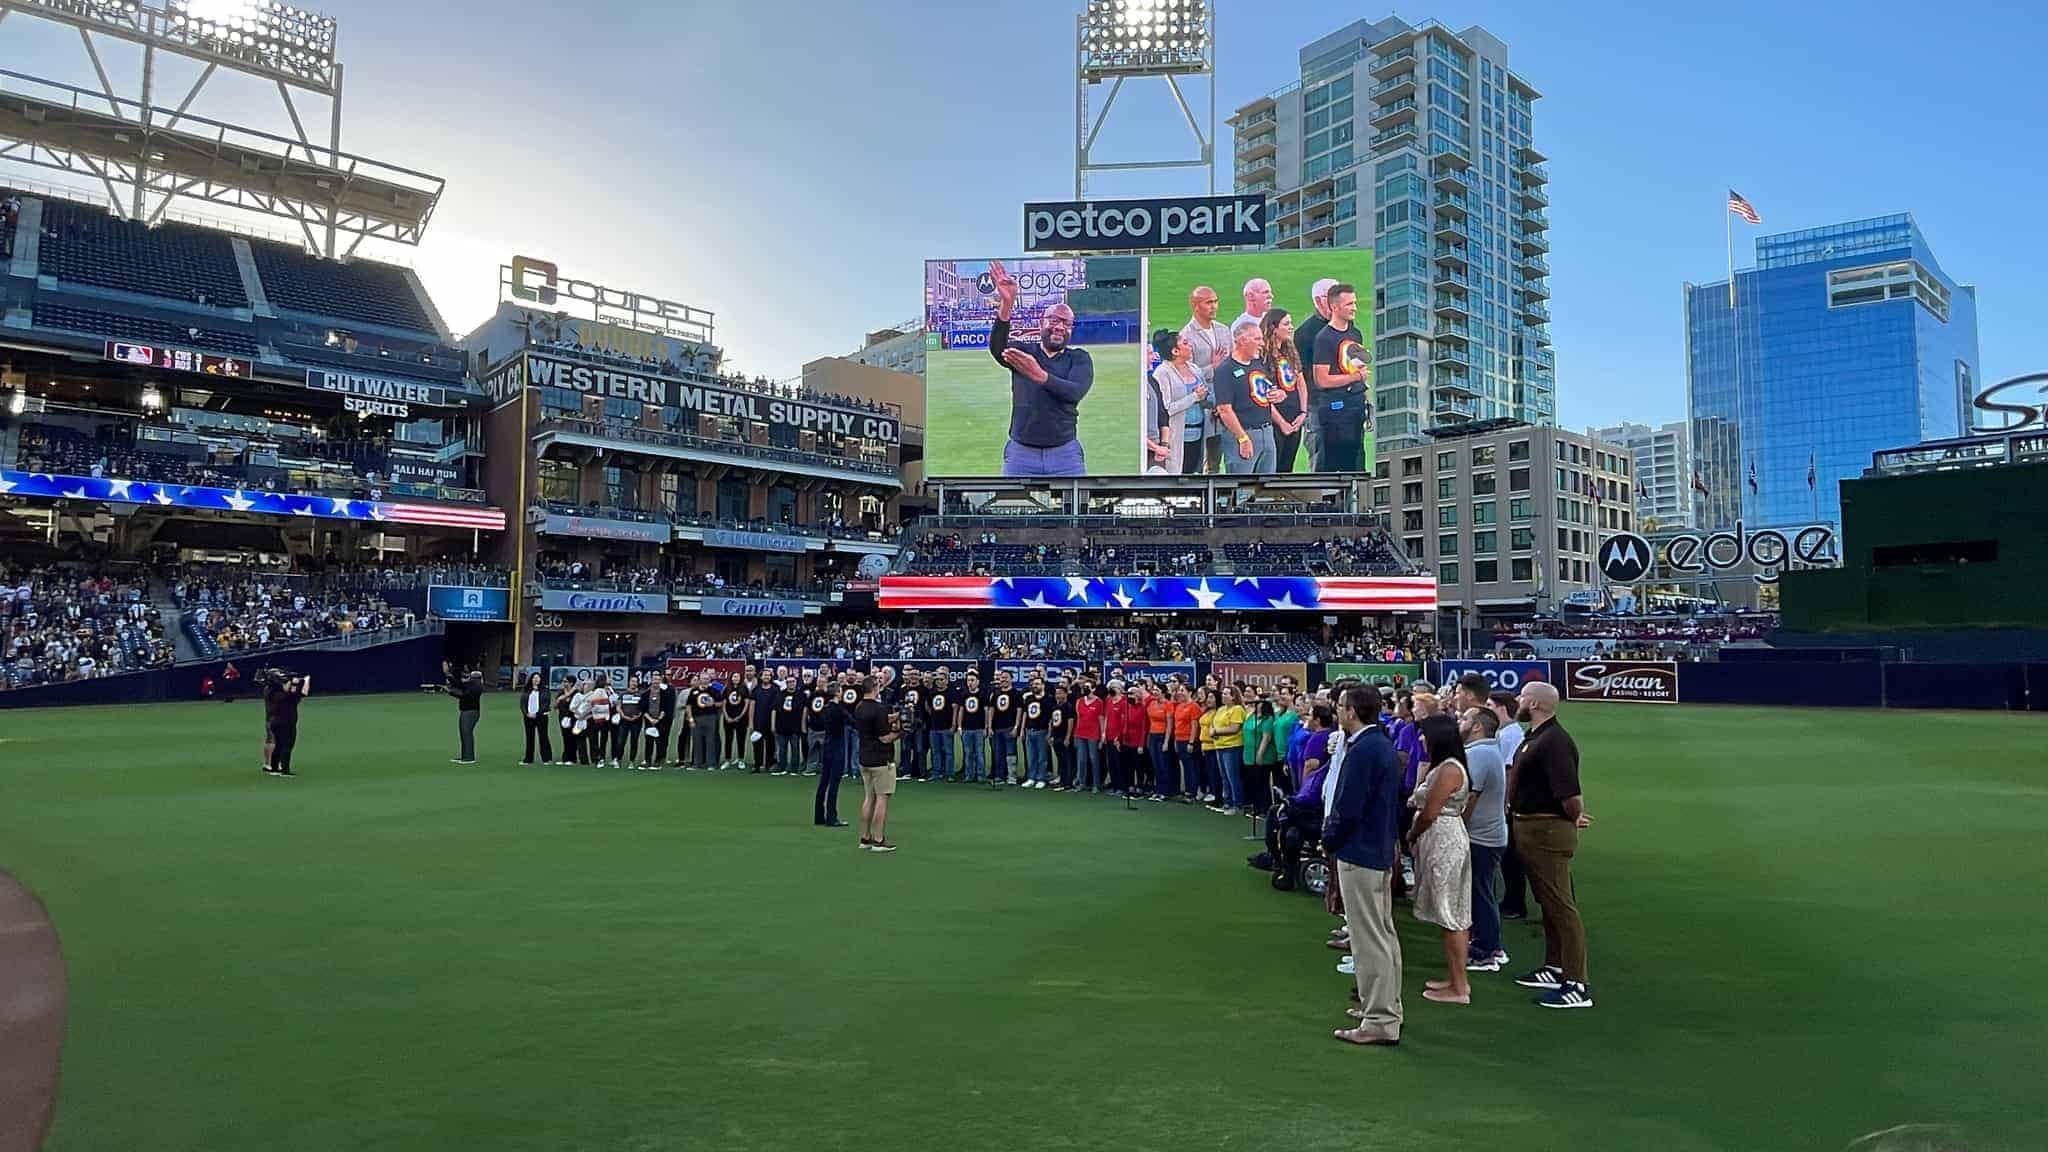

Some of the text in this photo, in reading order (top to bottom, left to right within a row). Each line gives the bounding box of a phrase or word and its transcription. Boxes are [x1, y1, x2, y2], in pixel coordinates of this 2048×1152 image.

[1028, 201, 1261, 249] petco park
[568, 280, 709, 324] QUIDEL
[953, 334, 986, 344] ARCO
[323, 372, 430, 402] CUTWATER
[344, 397, 409, 418] SPIRITS
[529, 358, 898, 442] WESTERN METAL SUPPLY CO.
[1667, 519, 1838, 584] edge
[567, 593, 647, 610] Canel's
[722, 599, 787, 616] Canel's
[535, 613, 563, 628] 336
[1000, 666, 1082, 683] GEC
[1218, 667, 1284, 688] illumi
[1446, 670, 1519, 689] ACO
[1574, 664, 1666, 697] Sycuan
